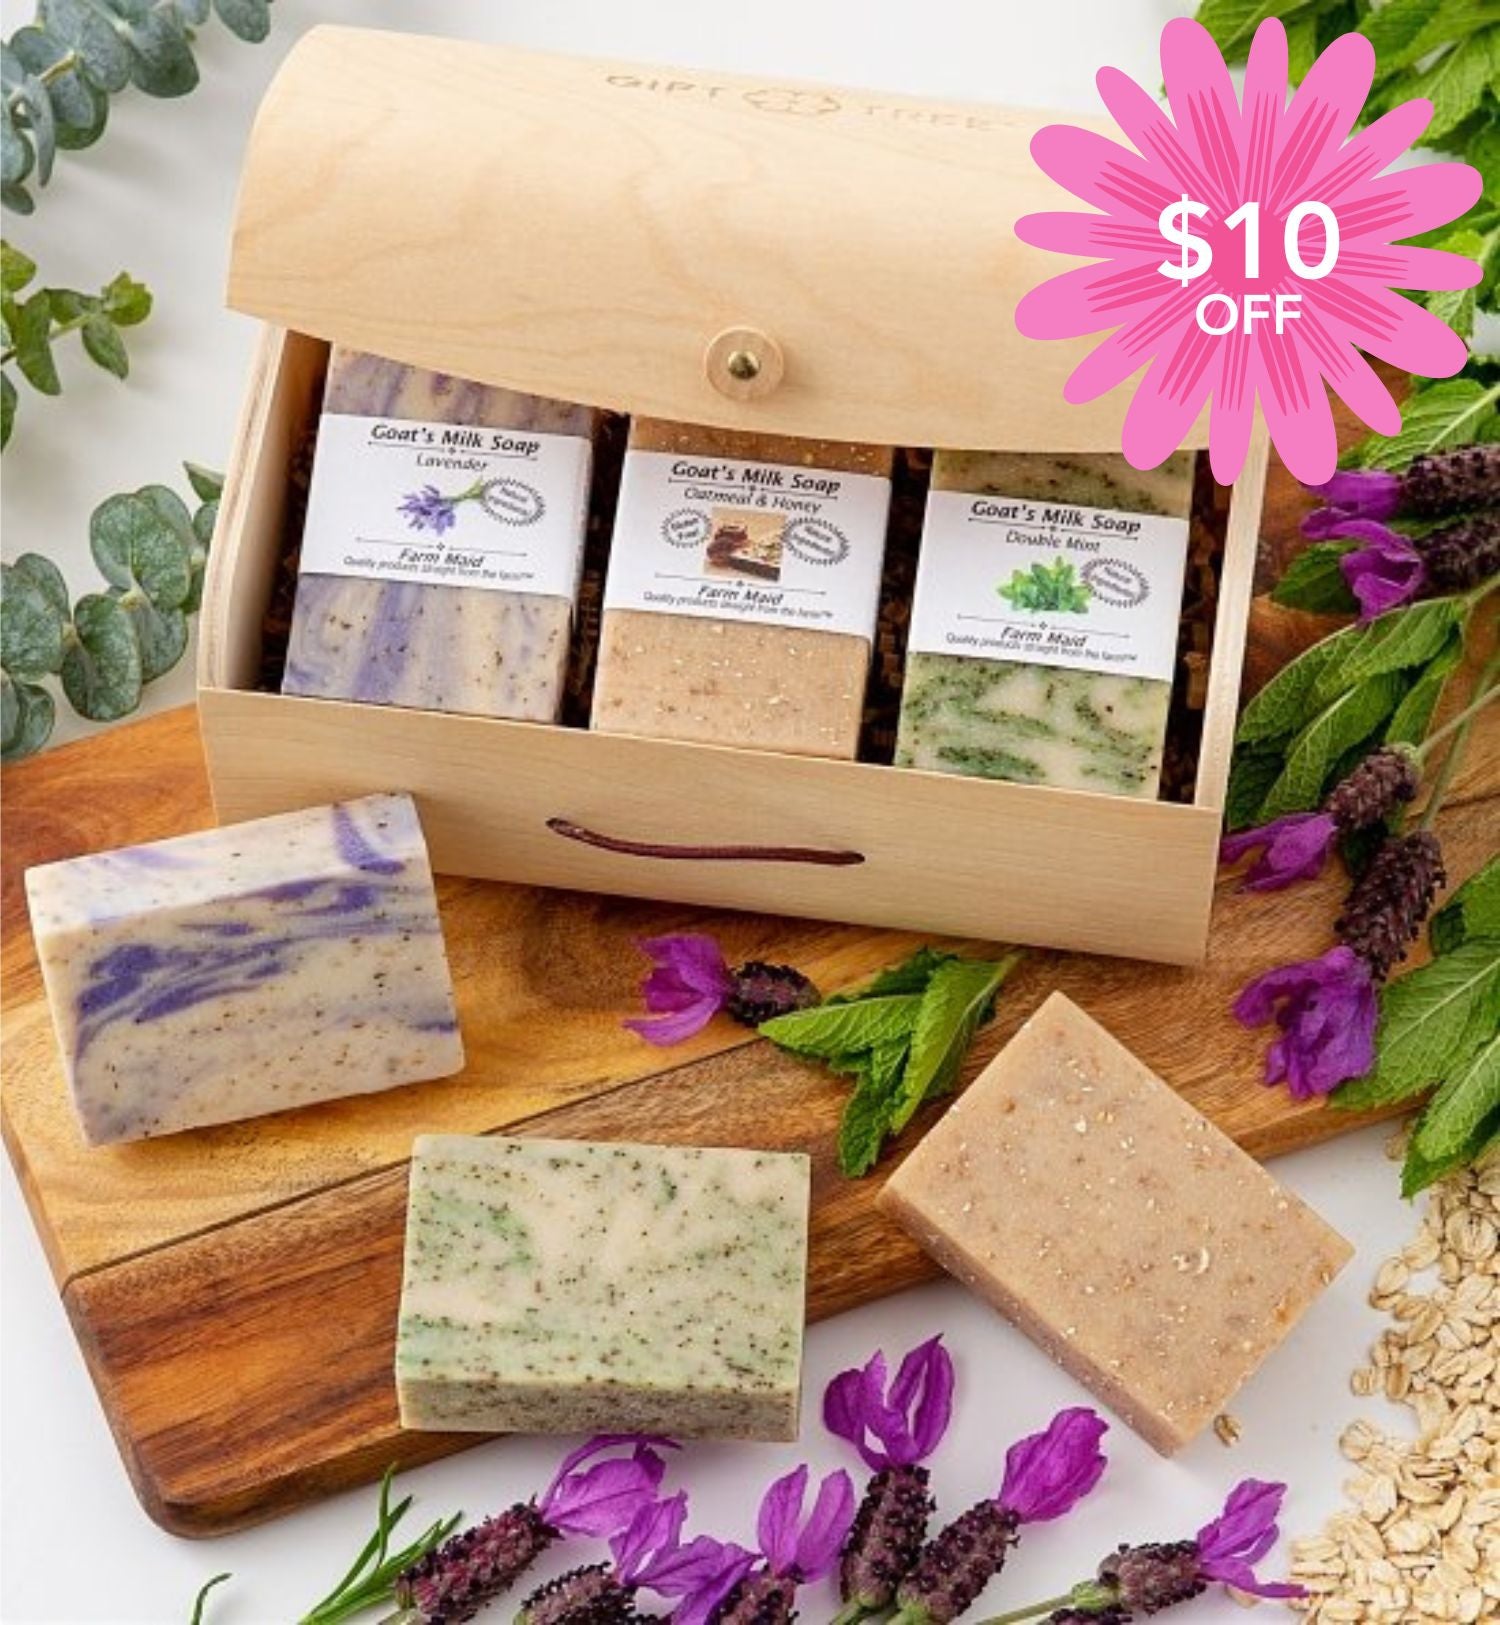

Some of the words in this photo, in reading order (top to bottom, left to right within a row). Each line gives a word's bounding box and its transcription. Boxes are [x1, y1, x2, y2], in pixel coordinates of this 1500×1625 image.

[371, 424, 435, 445] Goat's
[441, 430, 483, 448] Milk
[491, 434, 541, 454] Soap
[416, 453, 489, 473] Lavender
[671, 460, 736, 482] Goat's
[741, 468, 784, 487] Milk
[791, 473, 842, 495] Soap
[683, 487, 752, 505] Oatmeal
[754, 494, 767, 507] &
[771, 497, 822, 514] Honey
[971, 500, 1036, 522] Goat's
[1041, 508, 1084, 527] Milk
[1091, 513, 1142, 535] Soap
[1006, 530, 1061, 549] Double
[1066, 537, 1101, 552] Mint
[400, 547, 440, 564] Farm
[444, 553, 485, 568] Maid
[699, 585, 740, 600] Farm
[743, 590, 784, 606] Maid
[1001, 626, 1043, 642] Farm
[1047, 632, 1088, 648] Maid
